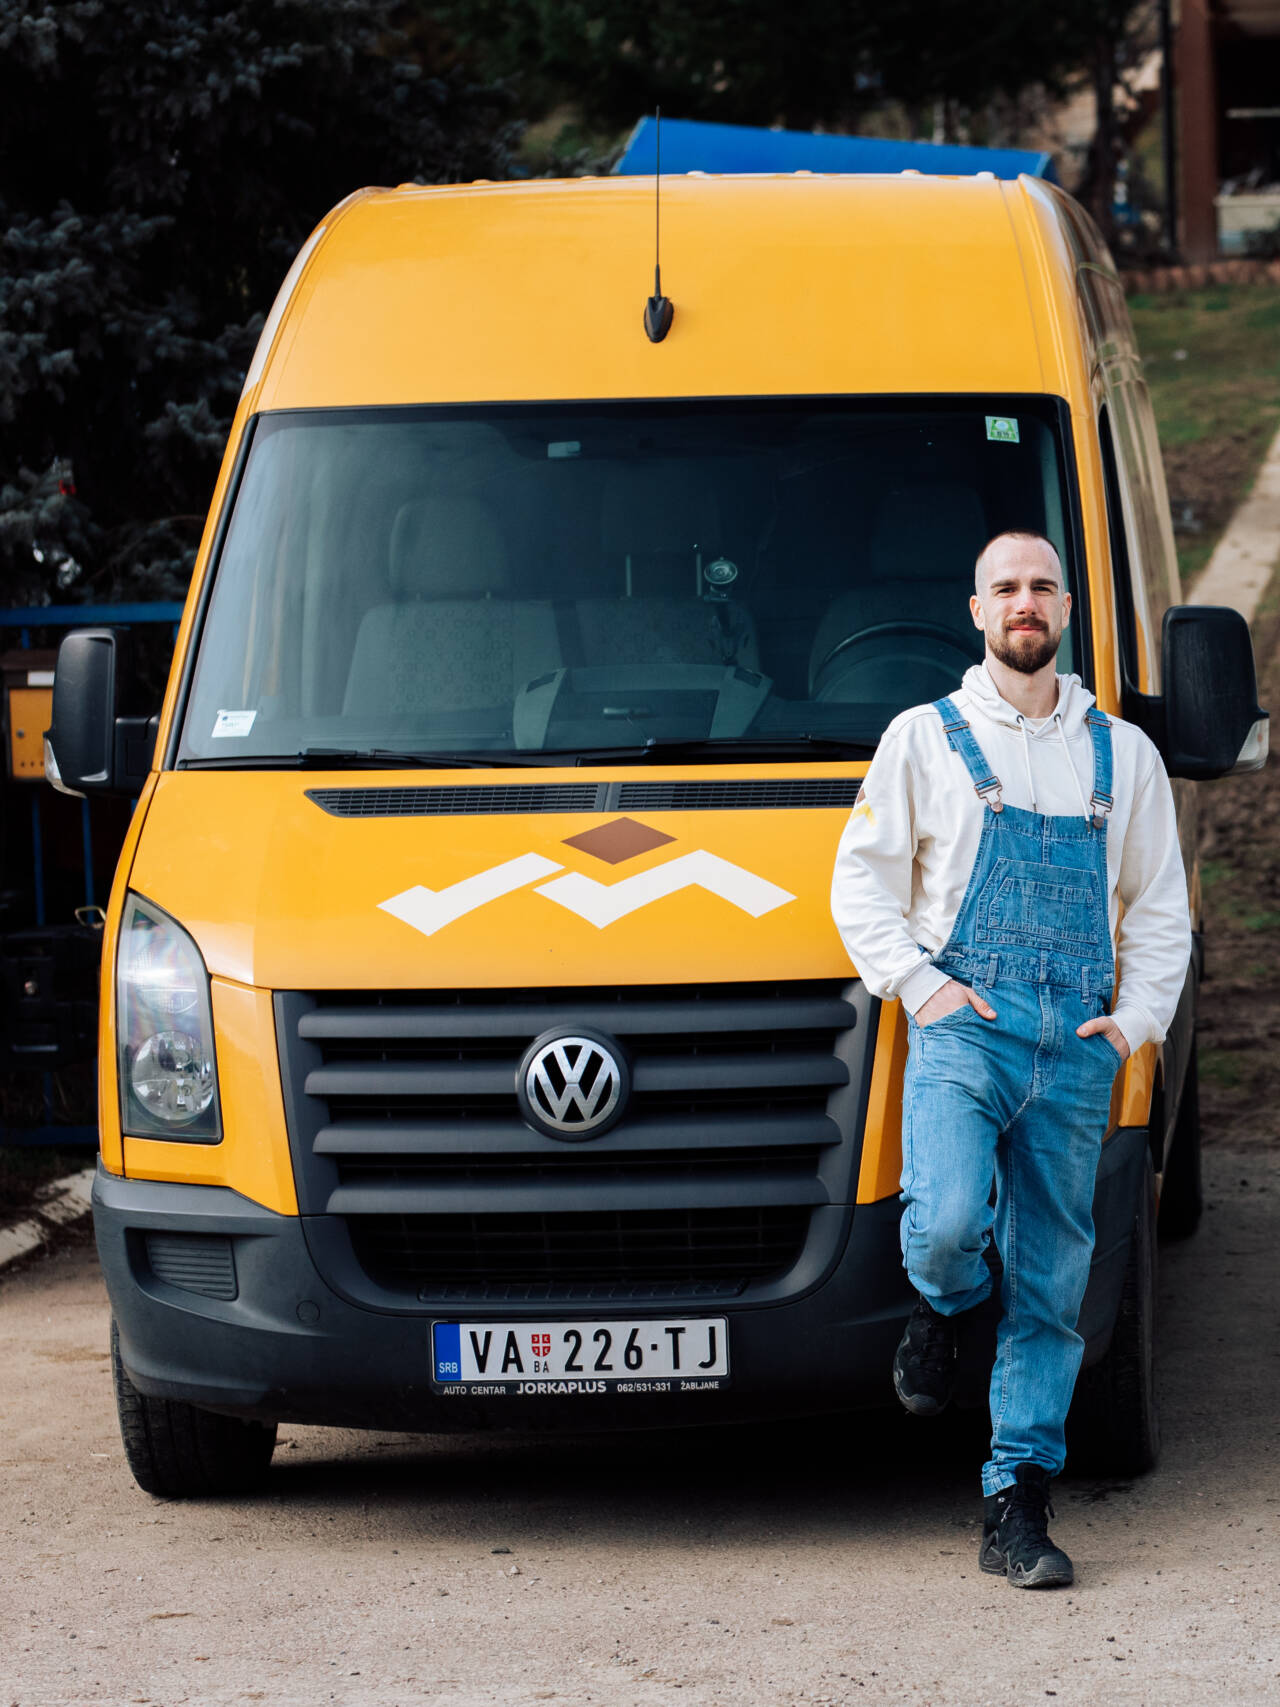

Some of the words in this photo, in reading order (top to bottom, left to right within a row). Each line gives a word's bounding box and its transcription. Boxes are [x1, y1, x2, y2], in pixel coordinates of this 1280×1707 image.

[469, 1330, 524, 1374] VA
[439, 1362, 458, 1373] SRB
[533, 1361, 549, 1373] BA
[443, 1386, 467, 1395] AUTO
[471, 1386, 506, 1395] CENTAR
[516, 1381, 607, 1394] JORKAPLUS
[617, 1382, 671, 1392] 062/531-331
[680, 1381, 719, 1390] ŽABLJANE
